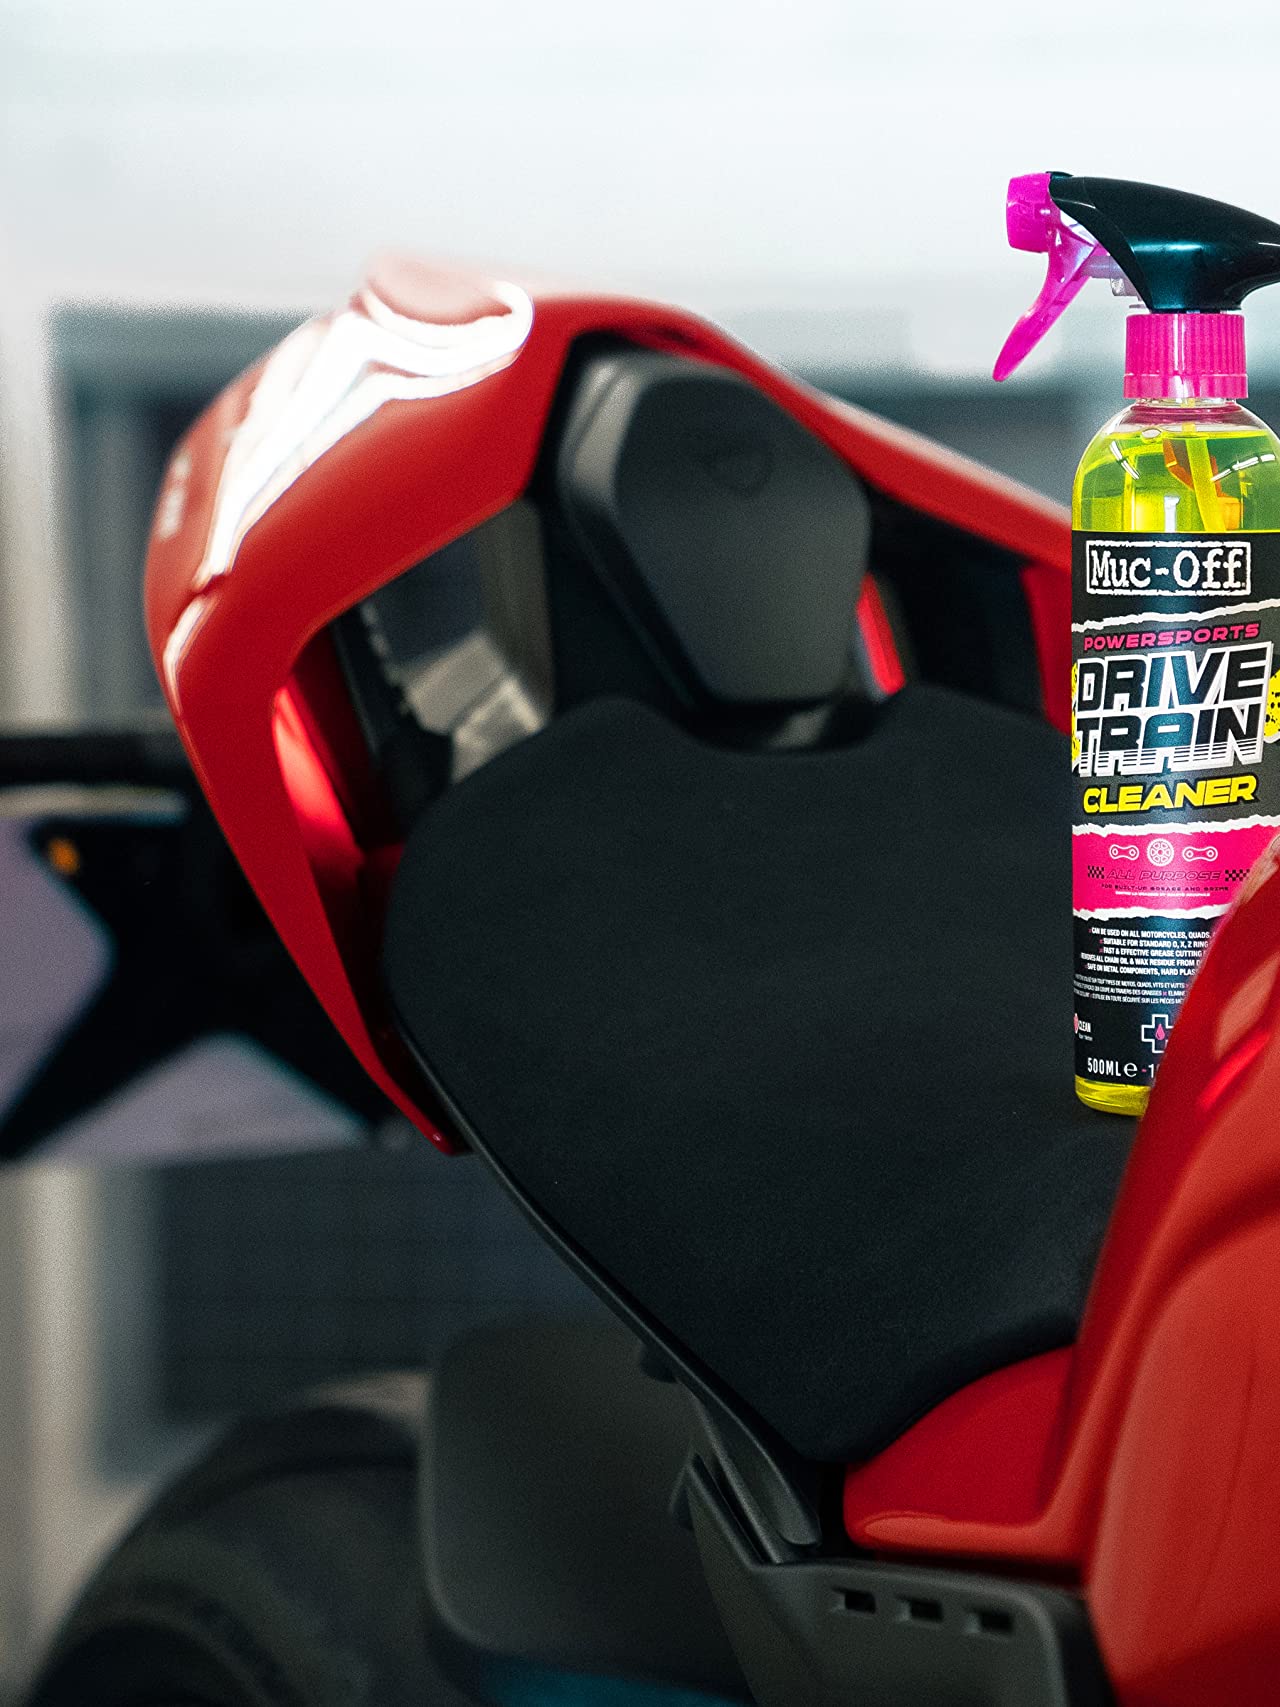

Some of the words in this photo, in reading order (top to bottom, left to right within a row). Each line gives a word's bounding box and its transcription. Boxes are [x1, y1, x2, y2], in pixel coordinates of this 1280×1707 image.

[1090, 548, 1244, 588] Muc-Off
[1084, 623, 1260, 651] POWERSPORTS
[1076, 641, 1273, 716] DRIVE
[1076, 702, 1264, 777] TRAIN
[1083, 775, 1257, 813] CLEANER
[1106, 869, 1135, 880] ALL
[1139, 870, 1221, 882] PURPOSE
[1091, 926, 1100, 935] CAN
[1100, 928, 1107, 936] BE
[1107, 928, 1120, 937] USED
[1120, 929, 1129, 937] ON
[1129, 930, 1140, 938] ALL
[1140, 930, 1188, 940] MOTORCYCLES,
[1103, 937, 1126, 947] SUITABLE
[1127, 938, 1138, 947] FOR
[1138, 940, 1172, 949] STANDARD
[1180, 940, 1187, 949] X,
[1187, 940, 1192, 948] Z
[1103, 946, 1115, 954] FAST
[1115, 947, 1120, 955] &
[1120, 948, 1150, 957] EFFECTIVE
[1150, 949, 1175, 957] GREASE
[1175, 949, 1203, 957] CUTTING
[1087, 962, 1096, 971] SAFE
[1096, 964, 1103, 972] ON
[1103, 964, 1119, 973] METAL
[1119, 966, 1160, 976] COMPONENTS,
[1160, 967, 1178, 976] HARD
[1179, 968, 1197, 976] PLAS
[1096, 955, 1104, 963] ALL
[1104, 956, 1119, 964] CHAIN
[1120, 957, 1129, 965] OIL
[1129, 957, 1135, 965] &
[1135, 958, 1149, 966] WAX
[1149, 959, 1175, 967] RESIDUE
[1176, 959, 1195, 967] FROM
[1087, 1057, 1121, 1077] 500ML
